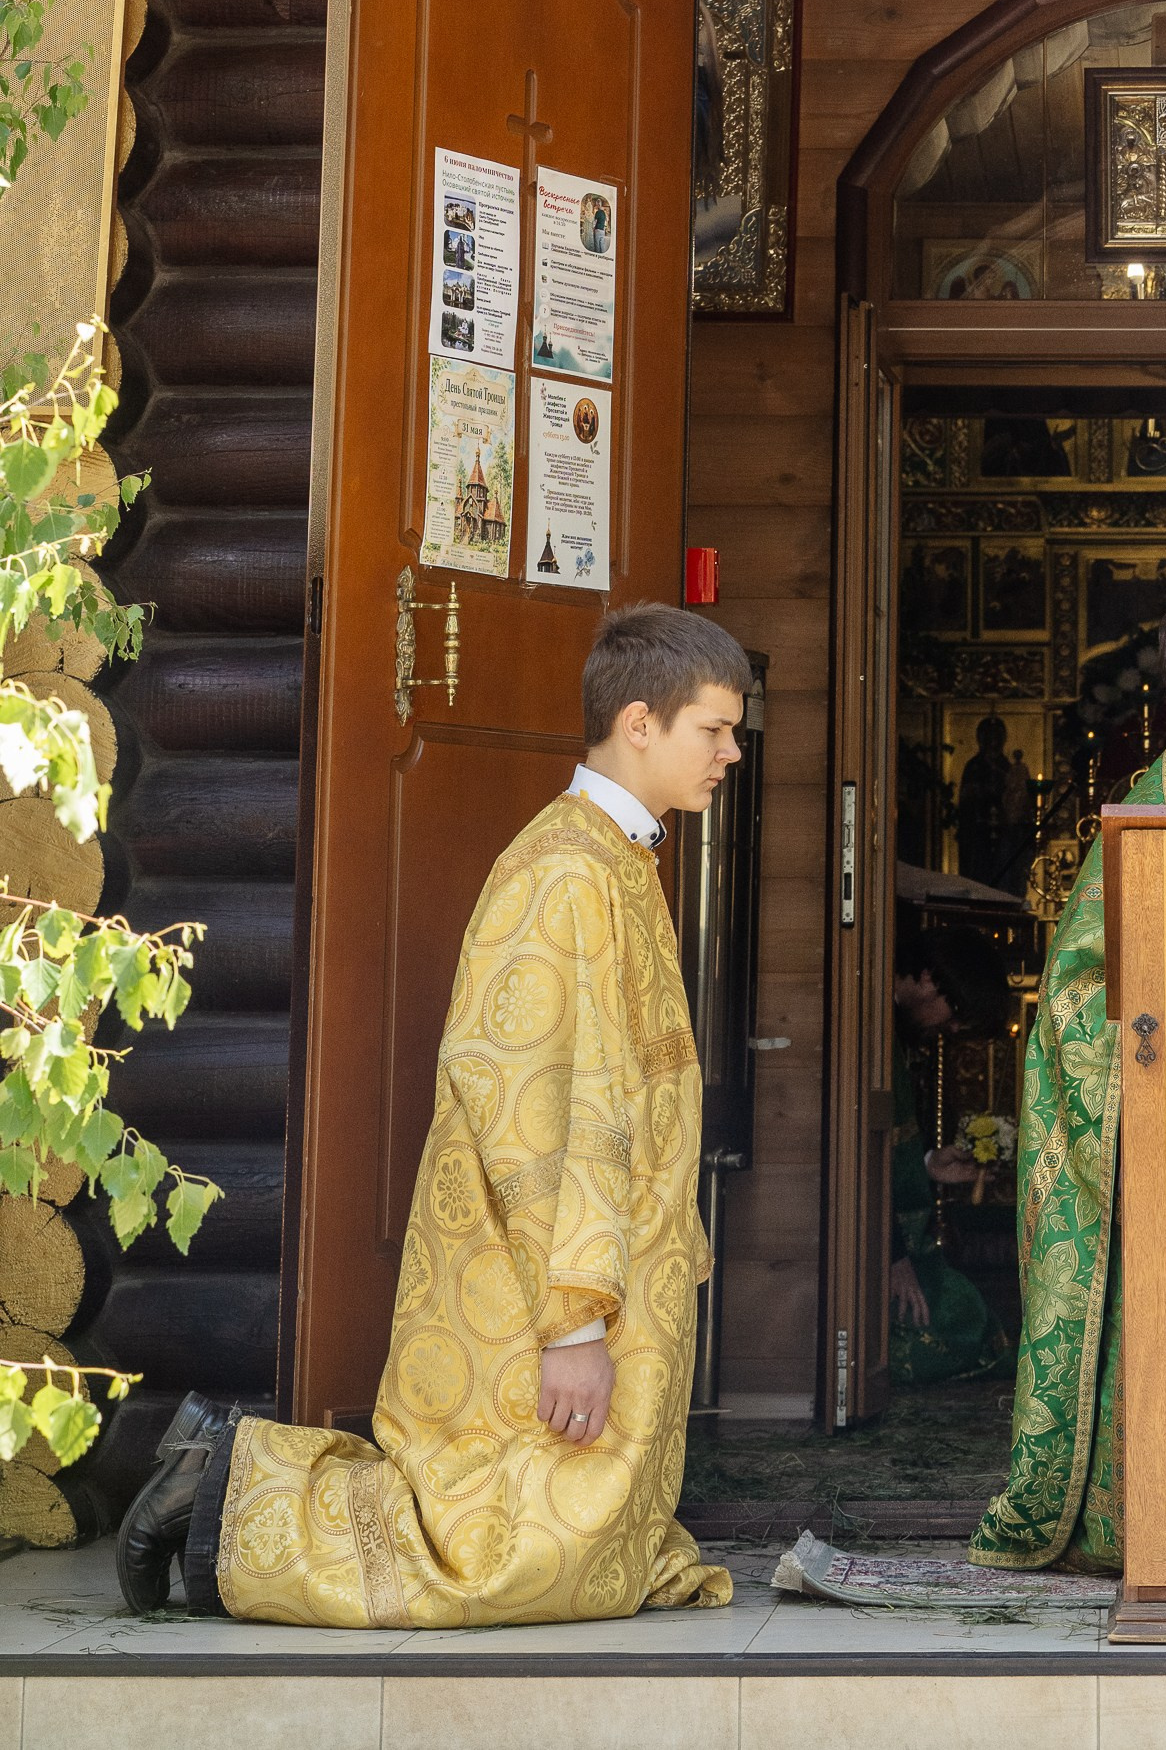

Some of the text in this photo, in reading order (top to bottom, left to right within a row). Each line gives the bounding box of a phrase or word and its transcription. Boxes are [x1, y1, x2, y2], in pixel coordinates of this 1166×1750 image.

[444, 154, 448, 163] 6
[472, 186, 490, 198] святой
[539, 185, 580, 207] Воскресные
[445, 378, 506, 407] День Святой Троицы
[462, 422, 483, 435] 31 мая
